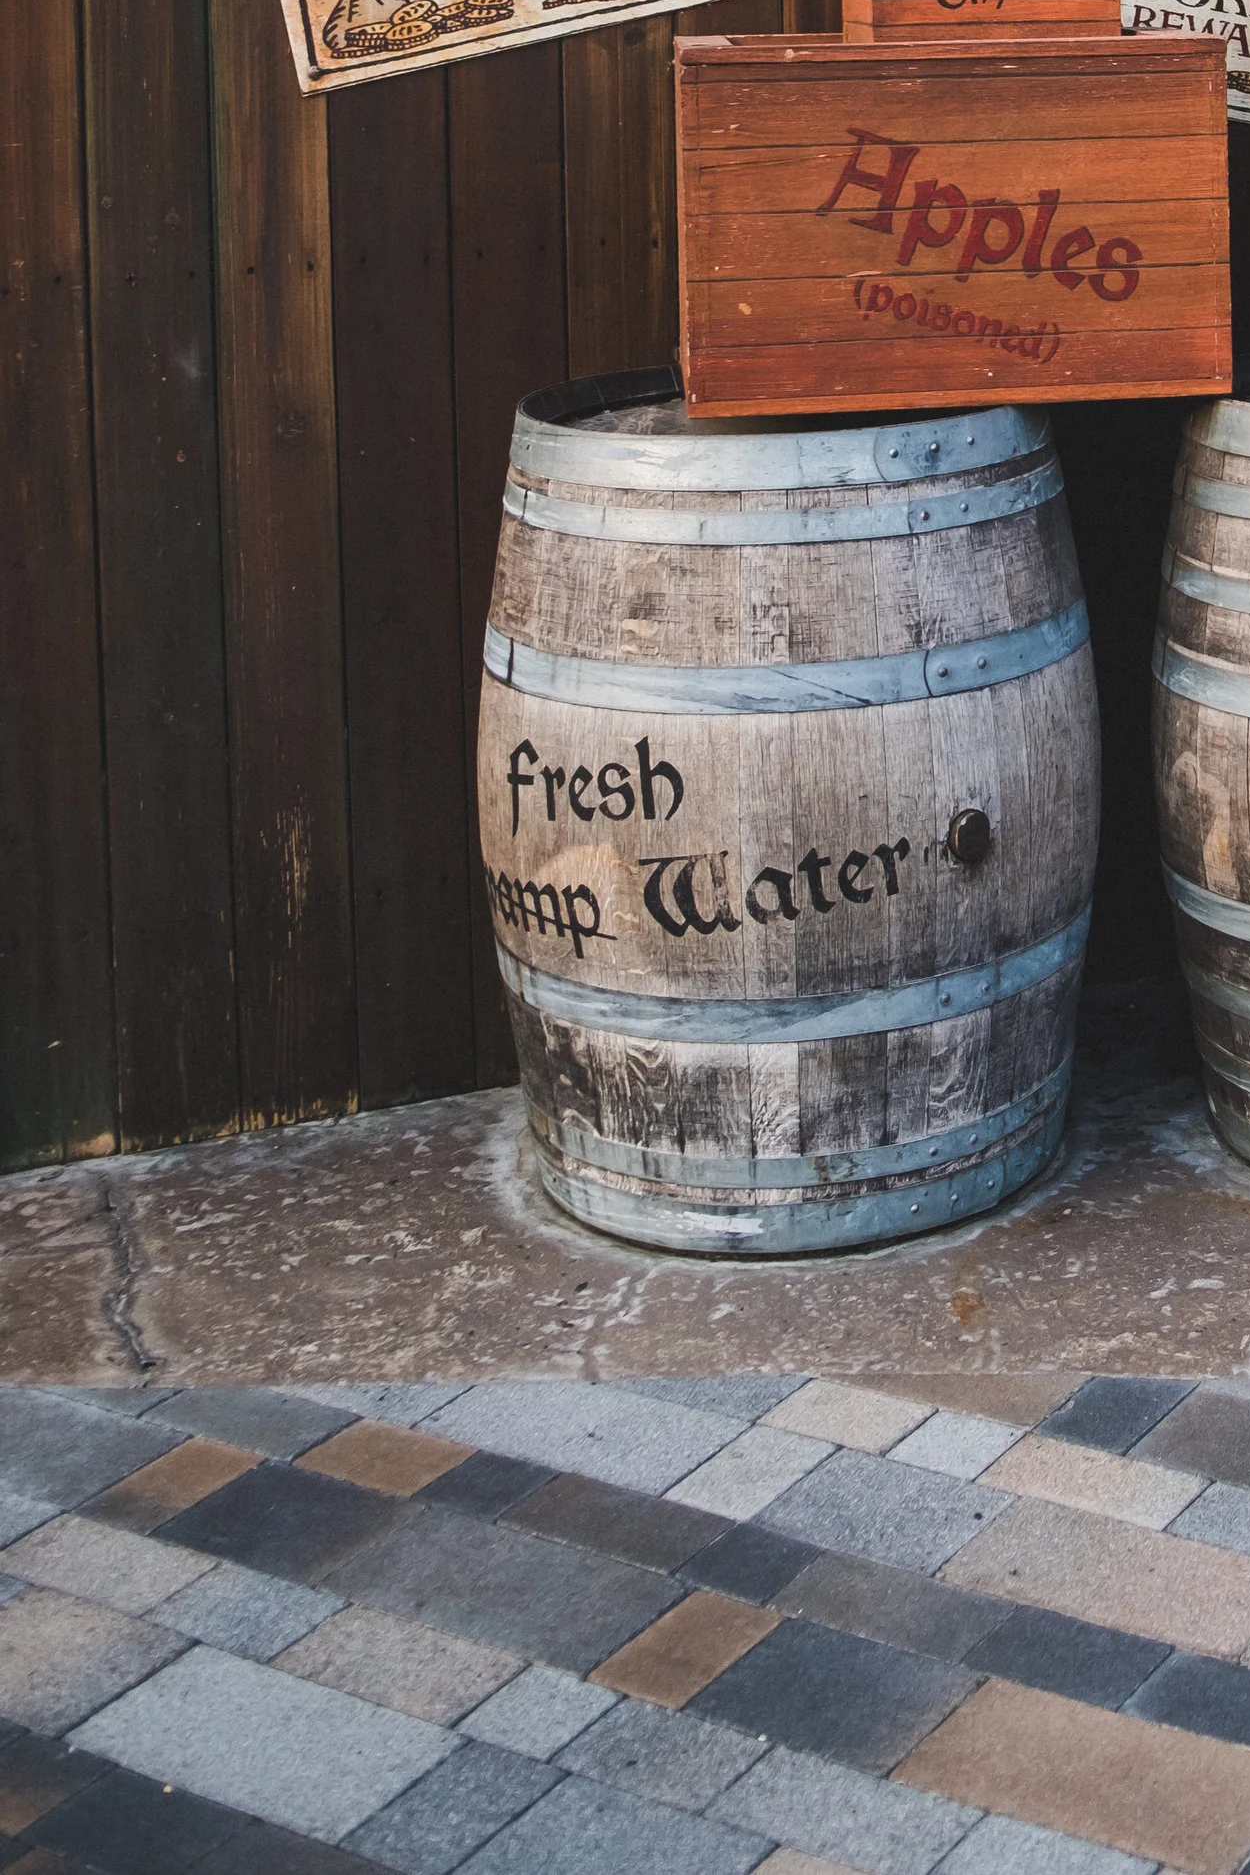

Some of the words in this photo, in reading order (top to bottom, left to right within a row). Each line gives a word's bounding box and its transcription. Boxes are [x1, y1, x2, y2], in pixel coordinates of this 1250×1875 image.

[815, 126, 1145, 302] Apples
[852, 278, 1062, 364] (poisoned)
[507, 735, 685, 838] fresh
[638, 836, 911, 938] Water
